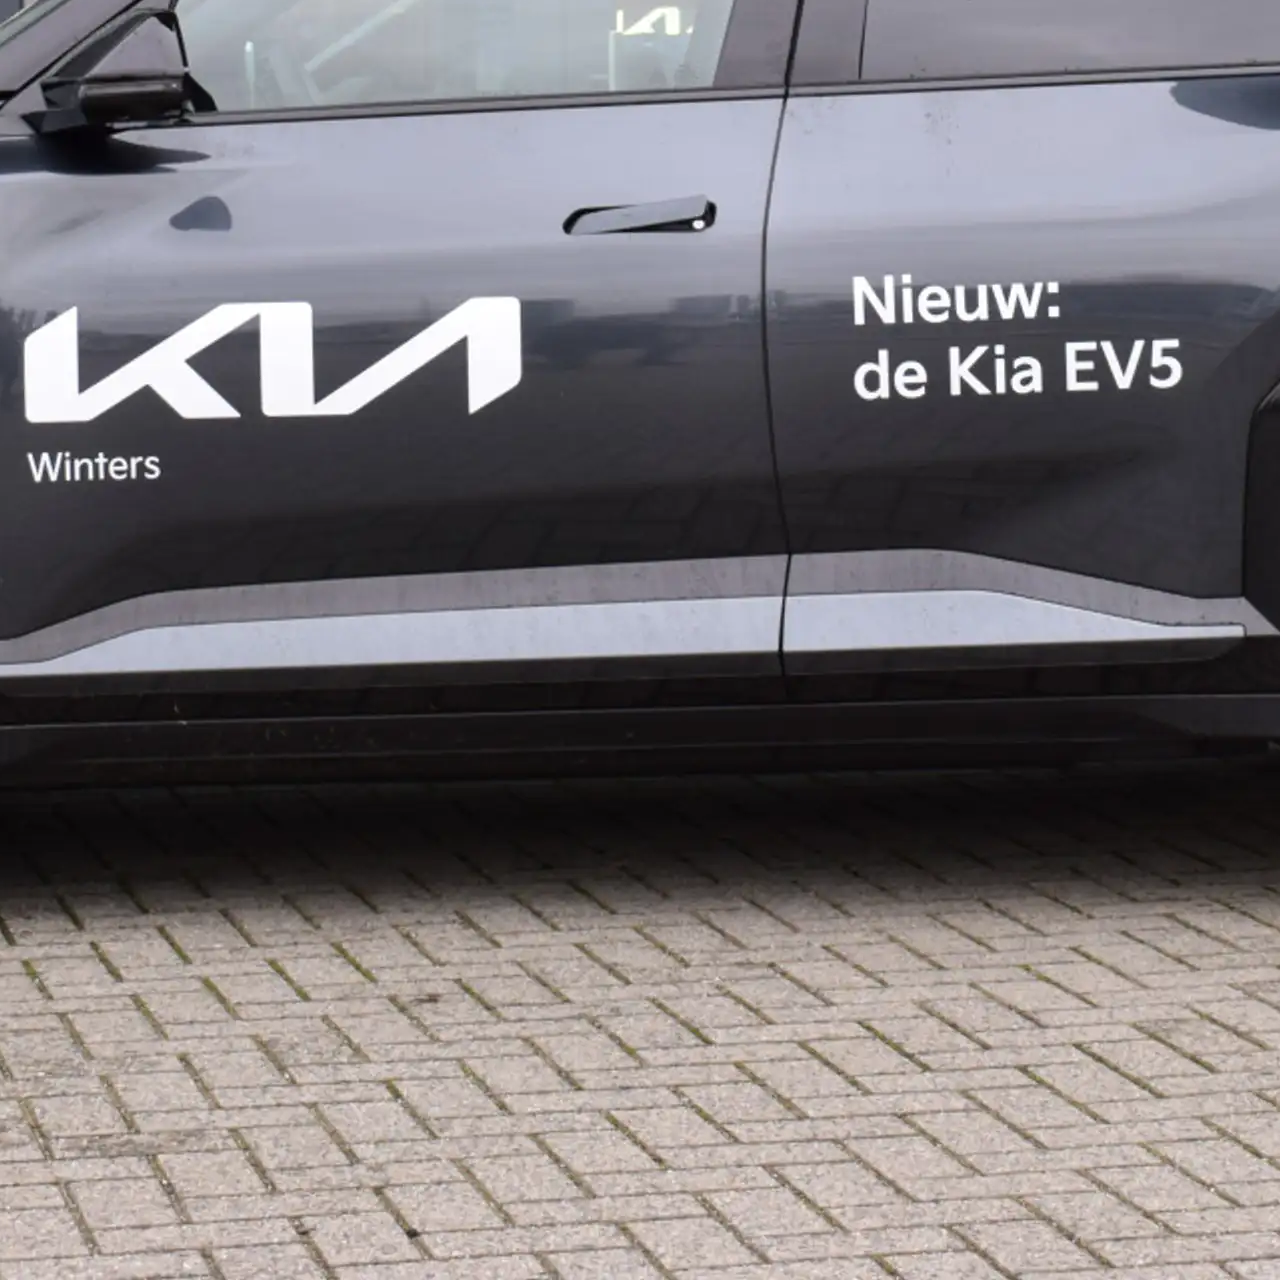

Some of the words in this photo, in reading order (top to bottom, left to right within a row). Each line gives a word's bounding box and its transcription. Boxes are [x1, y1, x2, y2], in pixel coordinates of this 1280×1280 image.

[851, 272, 1060, 326] Nieuw:
[23, 295, 522, 424] KIA
[854, 348, 928, 401] de
[948, 344, 1043, 396] Kia
[1065, 338, 1183, 392] EV5
[26, 451, 161, 483] Winters
